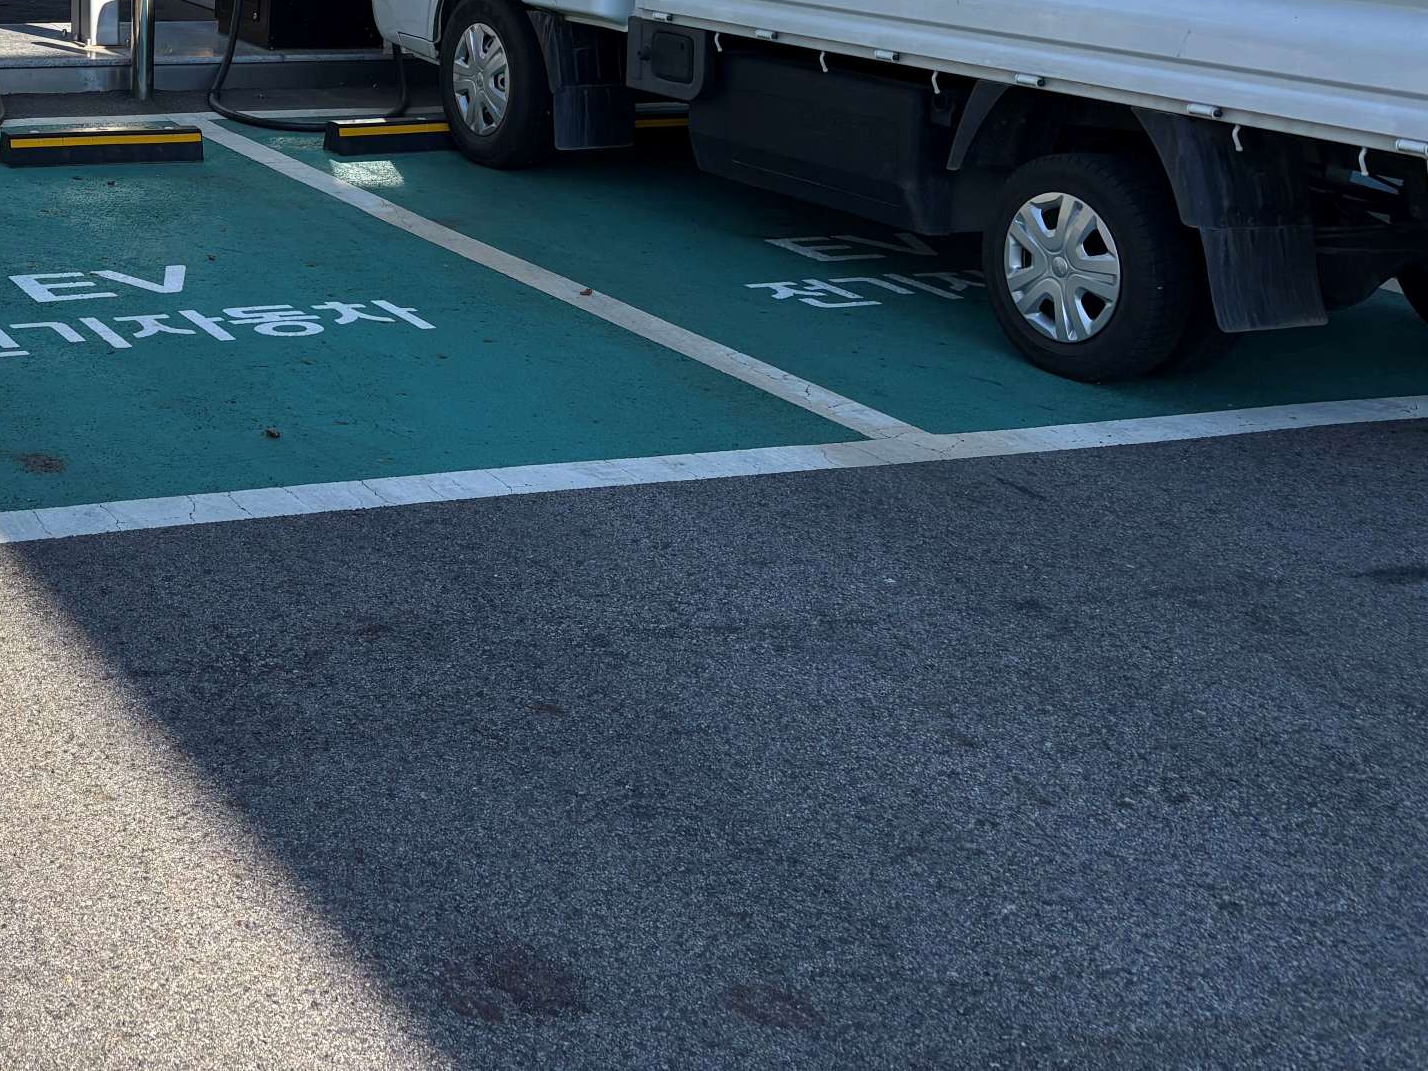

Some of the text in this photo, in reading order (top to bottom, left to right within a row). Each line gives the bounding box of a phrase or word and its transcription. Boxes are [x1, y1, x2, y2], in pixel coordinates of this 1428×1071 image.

[764, 232, 939, 261] EV
[9, 265, 186, 303] EV
[744, 270, 987, 308] 전기자
